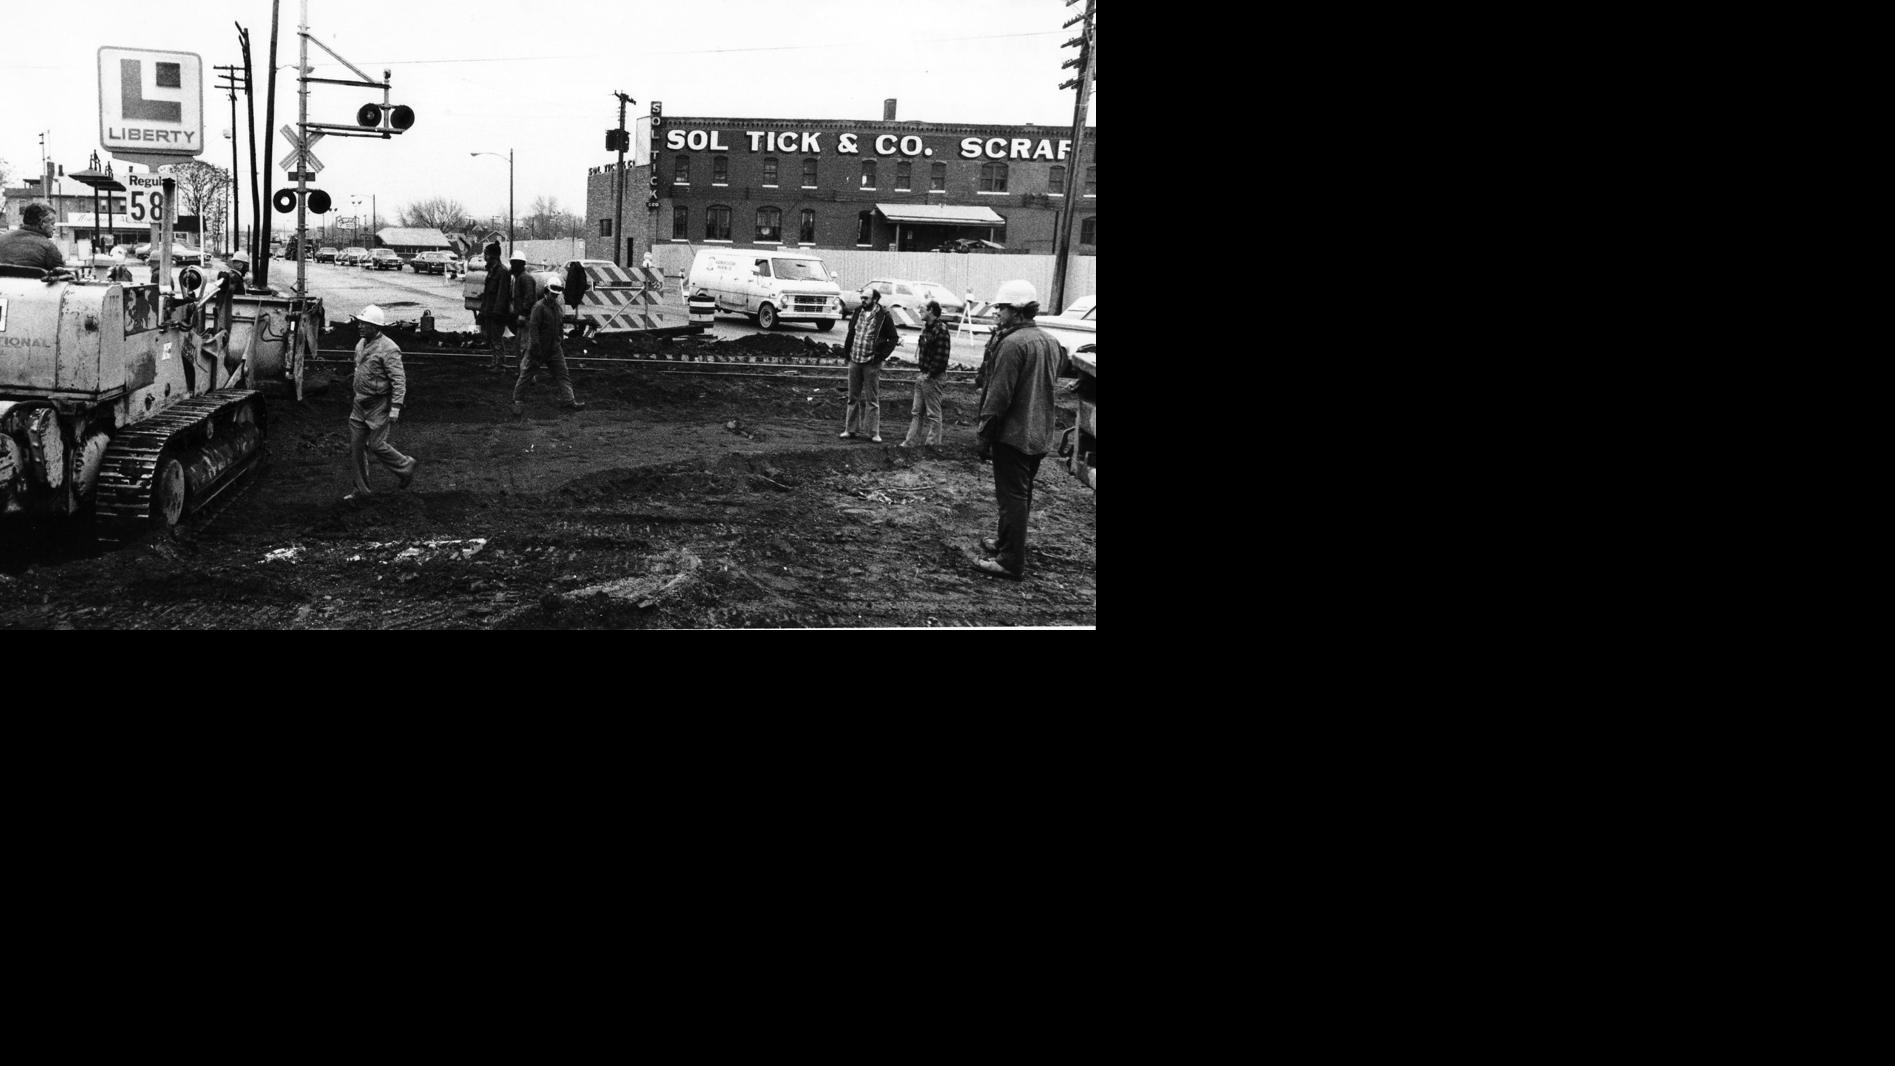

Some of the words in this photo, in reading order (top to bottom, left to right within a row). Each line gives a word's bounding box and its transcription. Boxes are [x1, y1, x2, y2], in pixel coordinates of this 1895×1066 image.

[109, 127, 195, 143] LIBERTY
[666, 129, 729, 151] SOL
[746, 131, 821, 153] TICK
[837, 132, 859, 153] &
[875, 134, 933, 156] CO.
[128, 175, 163, 188] Regul
[131, 190, 164, 221] 58
[0, 337, 51, 348] IONAL
